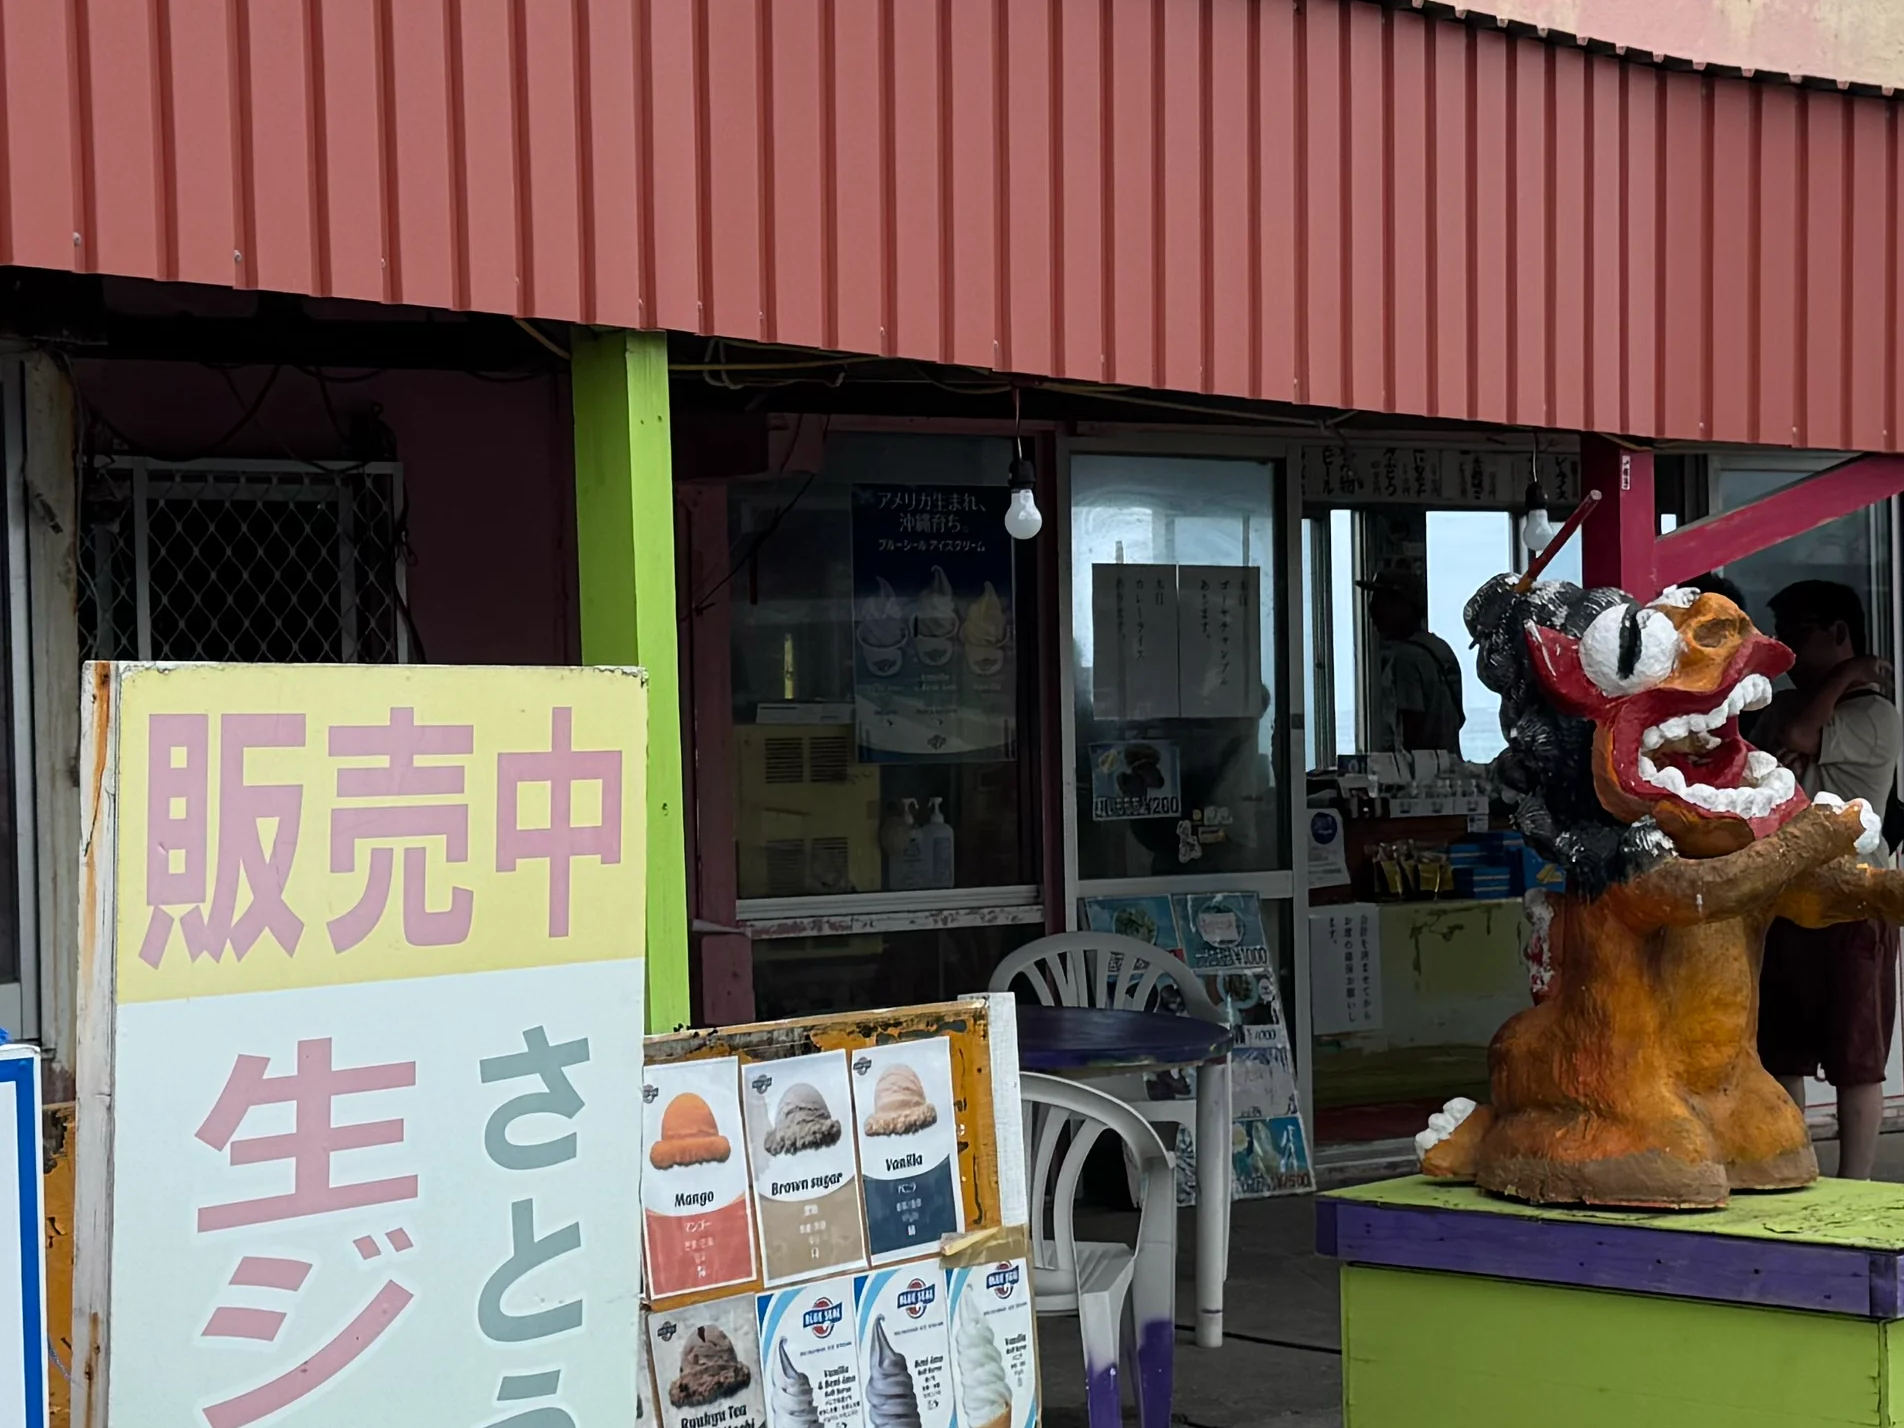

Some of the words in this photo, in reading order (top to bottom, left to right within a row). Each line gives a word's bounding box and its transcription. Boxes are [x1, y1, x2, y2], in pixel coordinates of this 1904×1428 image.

[138, 706, 624, 970] 販売中
[771, 1177, 809, 1197] Brown
[810, 1172, 844, 1189] sugar
[674, 1188, 715, 1208] Mango
[727, 1403, 748, 1418] Tea
